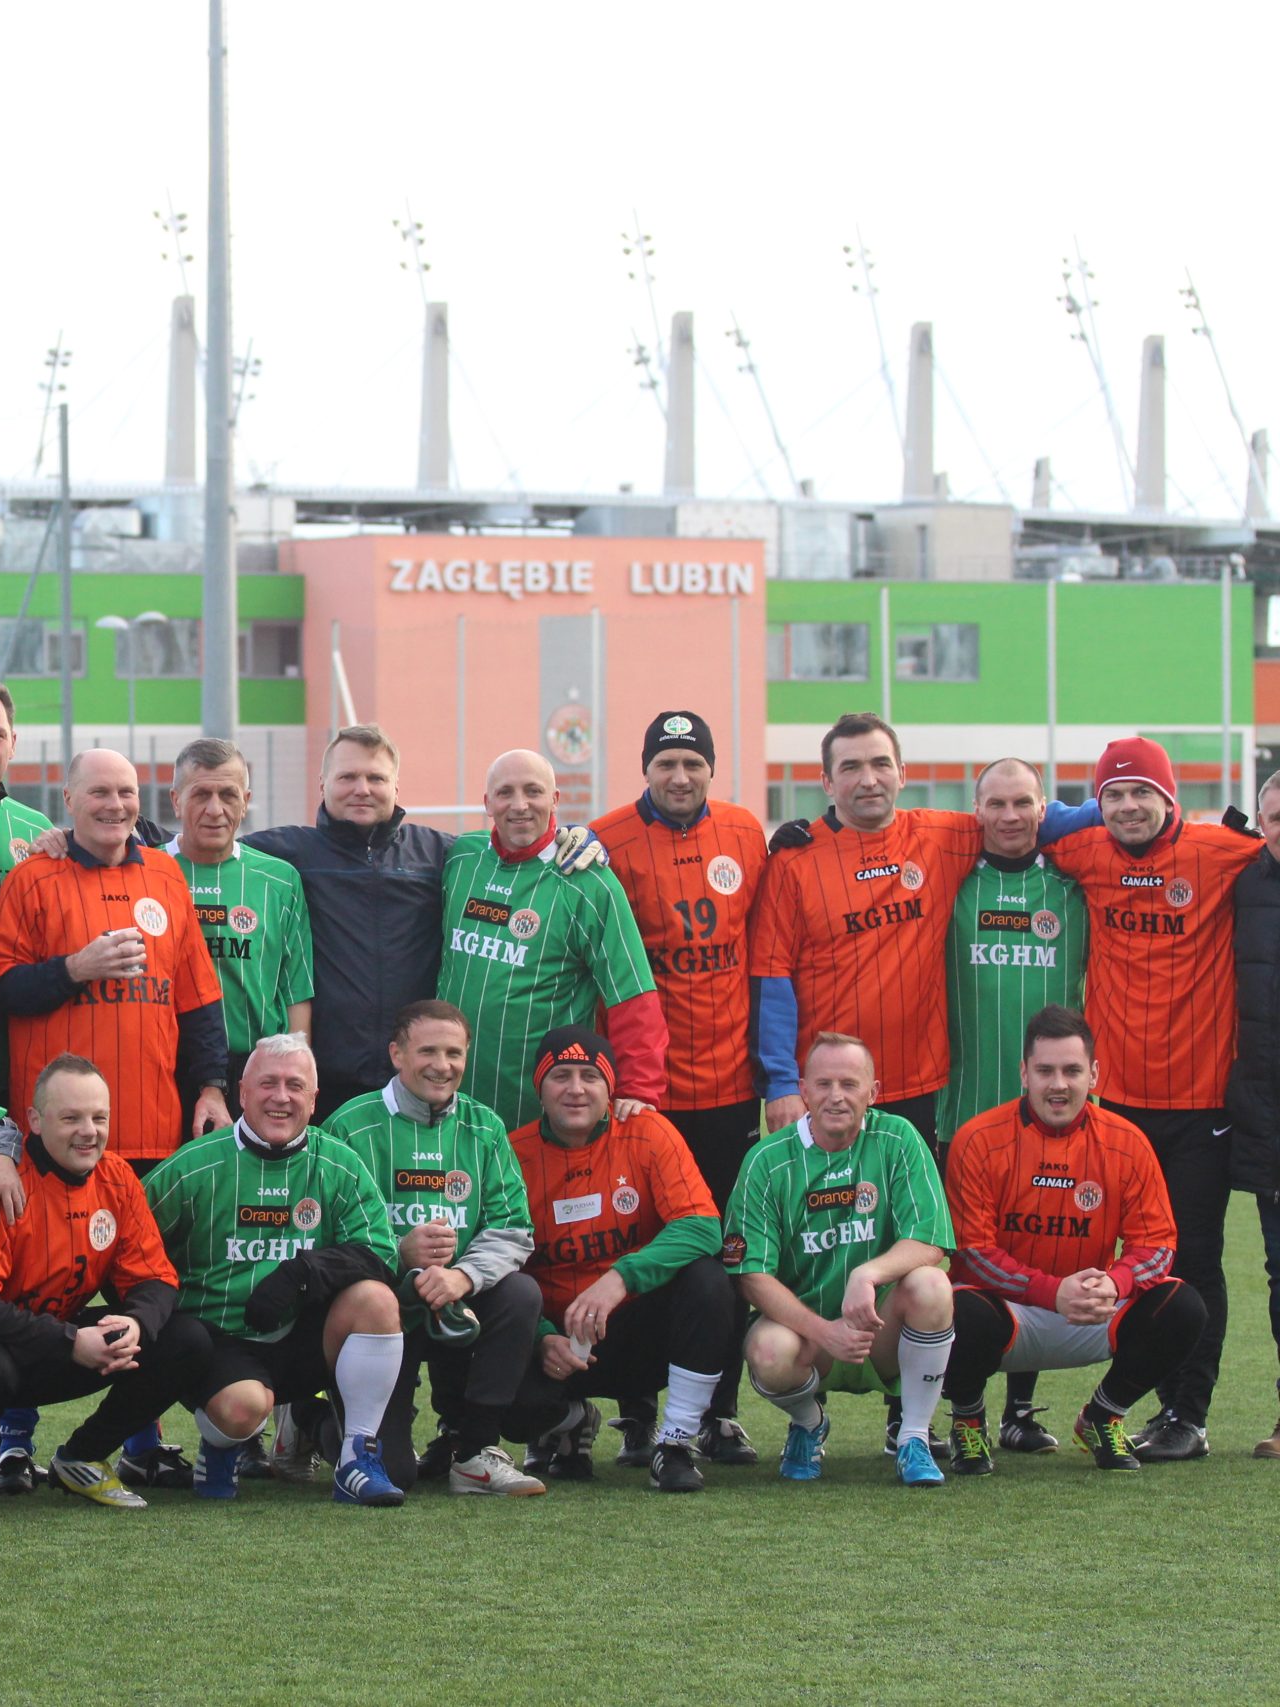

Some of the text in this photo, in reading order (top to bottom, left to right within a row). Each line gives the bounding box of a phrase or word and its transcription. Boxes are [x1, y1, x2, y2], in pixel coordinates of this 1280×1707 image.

[389, 559, 755, 600] ZAGŁĘBIE LUBIN
[673, 855, 703, 866] JAKO
[859, 855, 888, 865] JAKO
[856, 864, 899, 880] CANAL+
[189, 886, 222, 894] JAKO
[484, 883, 512, 896] JAKO
[1121, 876, 1163, 887] CANAL+
[101, 894, 130, 902] JAKO
[996, 895, 1027, 904] JAKO
[194, 909, 225, 923] ange
[467, 899, 509, 922] Orange
[673, 897, 718, 940] 19
[842, 898, 924, 934] KGHM
[981, 912, 1030, 929] Orange
[1104, 906, 1186, 936] KGHM
[205, 937, 252, 960] HM
[450, 928, 529, 967] KGHM
[969, 943, 1057, 968] KGHM
[646, 942, 739, 975] KGHM
[558, 1053, 589, 1061] adidas
[412, 1152, 443, 1161] JAKO
[823, 1167, 853, 1181] JAKO
[1038, 1162, 1069, 1171] JAKO
[397, 1171, 446, 1190] Orange
[1032, 1176, 1074, 1189] CANAL+
[257, 1187, 290, 1196] JAKO
[808, 1190, 855, 1207] Orange
[65, 1210, 89, 1220] JAK
[240, 1207, 289, 1226] Orange
[1001, 1212, 1093, 1238] KGHM
[800, 1218, 876, 1254] KGHM
[538, 1223, 639, 1268] KGHM
[64, 1254, 88, 1295] 3
